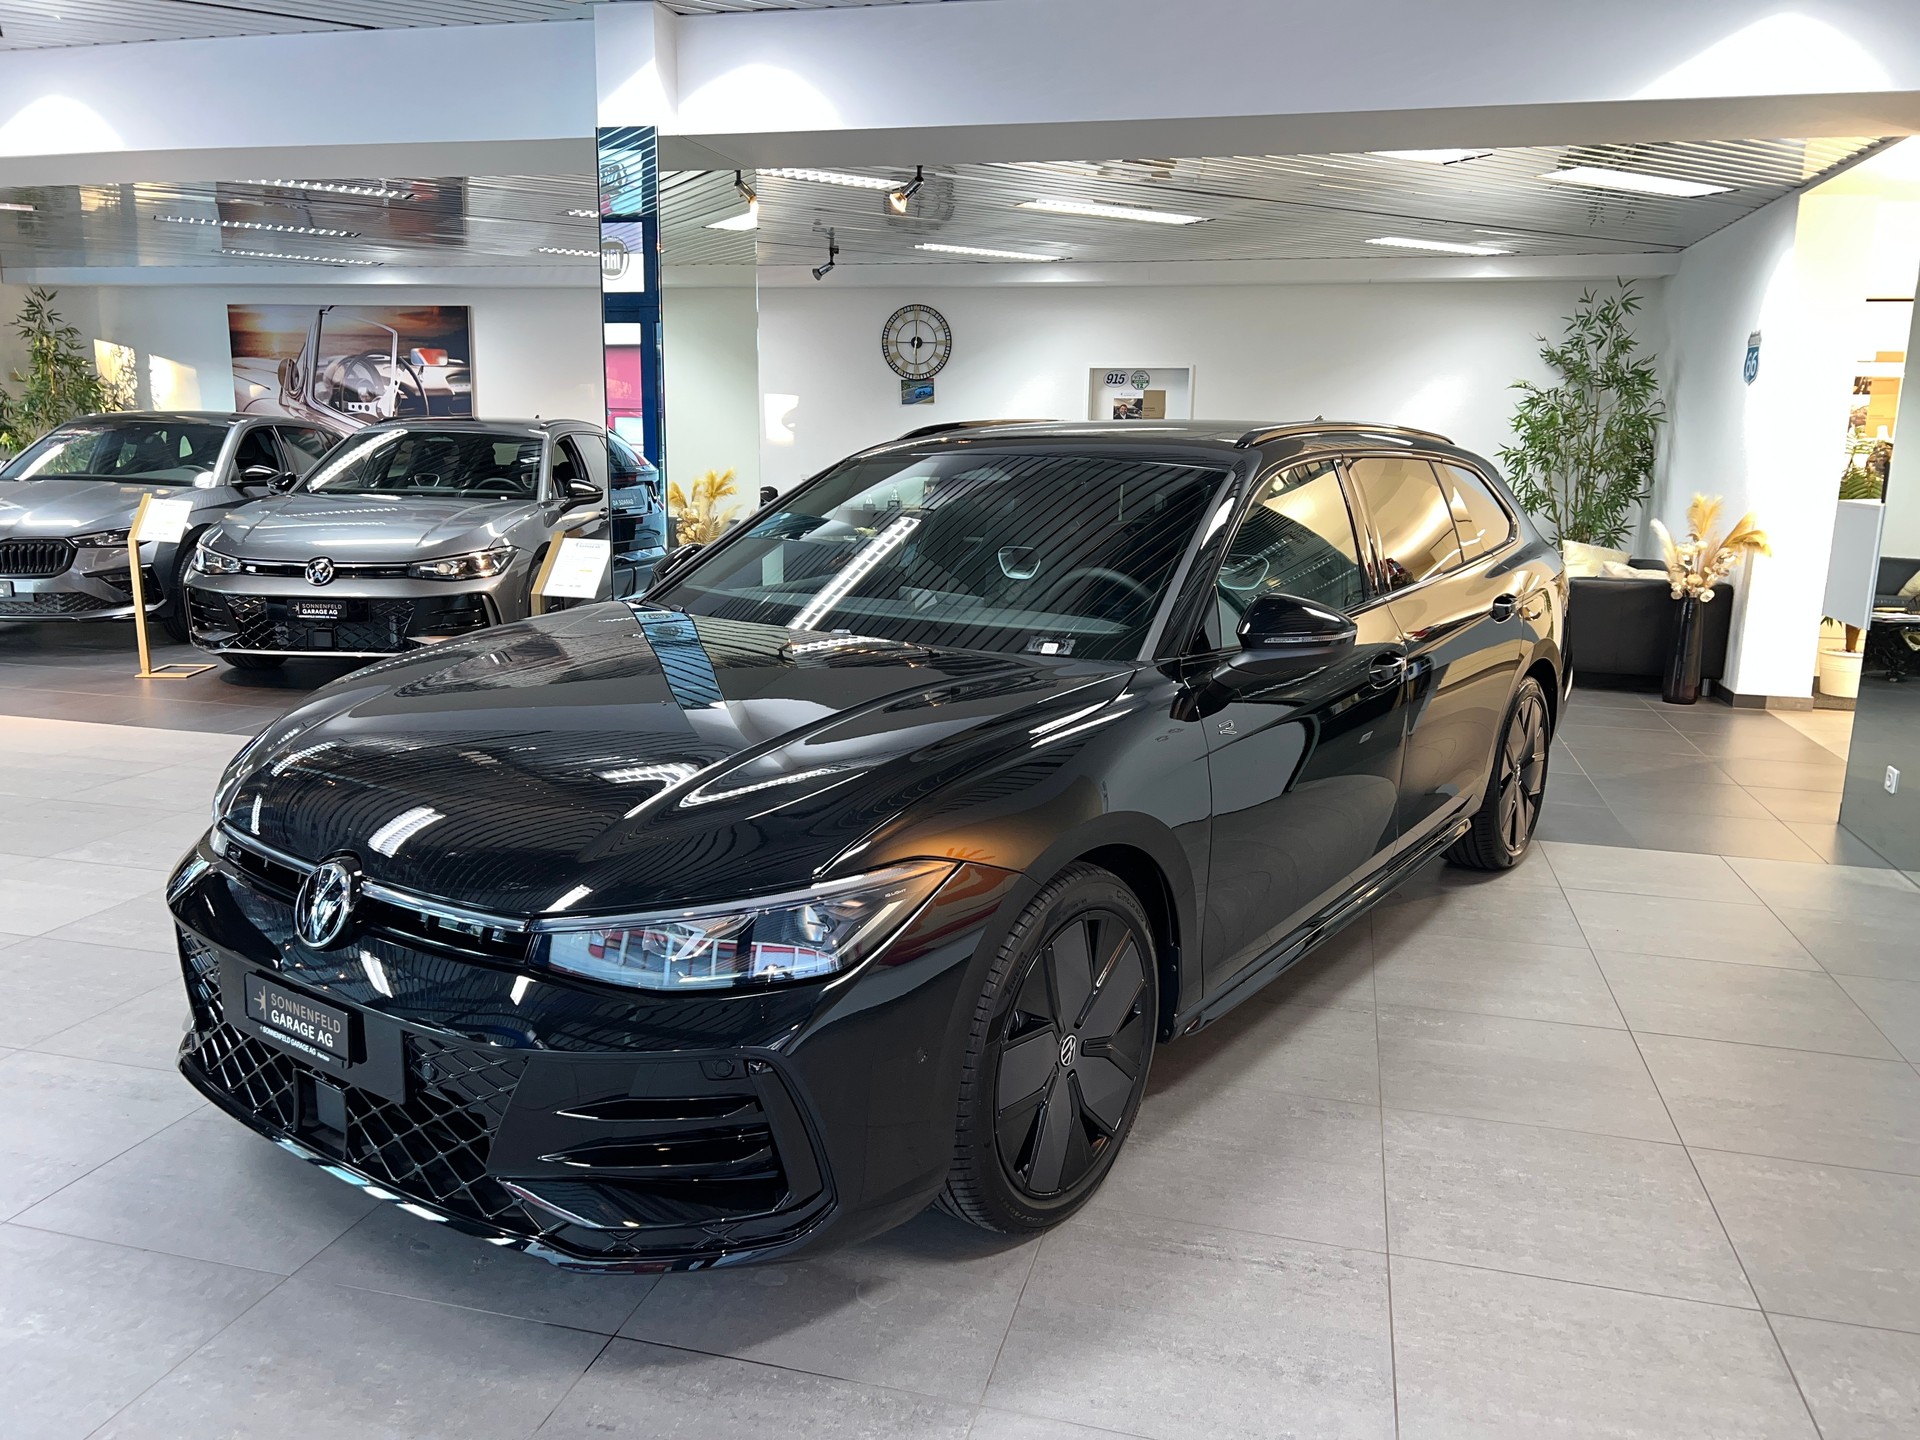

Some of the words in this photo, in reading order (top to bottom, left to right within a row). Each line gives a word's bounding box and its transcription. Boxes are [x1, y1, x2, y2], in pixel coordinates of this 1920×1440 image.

[1106, 373, 1126, 385] 915
[1745, 351, 1758, 377] 66
[271, 992, 341, 1034] SONNENFELD
[271, 1009, 315, 1040] GARAGE
[317, 1029, 334, 1048] AG
[262, 1025, 291, 1044] SONNENFELD
[290, 1038, 310, 1053] GARAGE
[308, 1047, 317, 1056] AG
